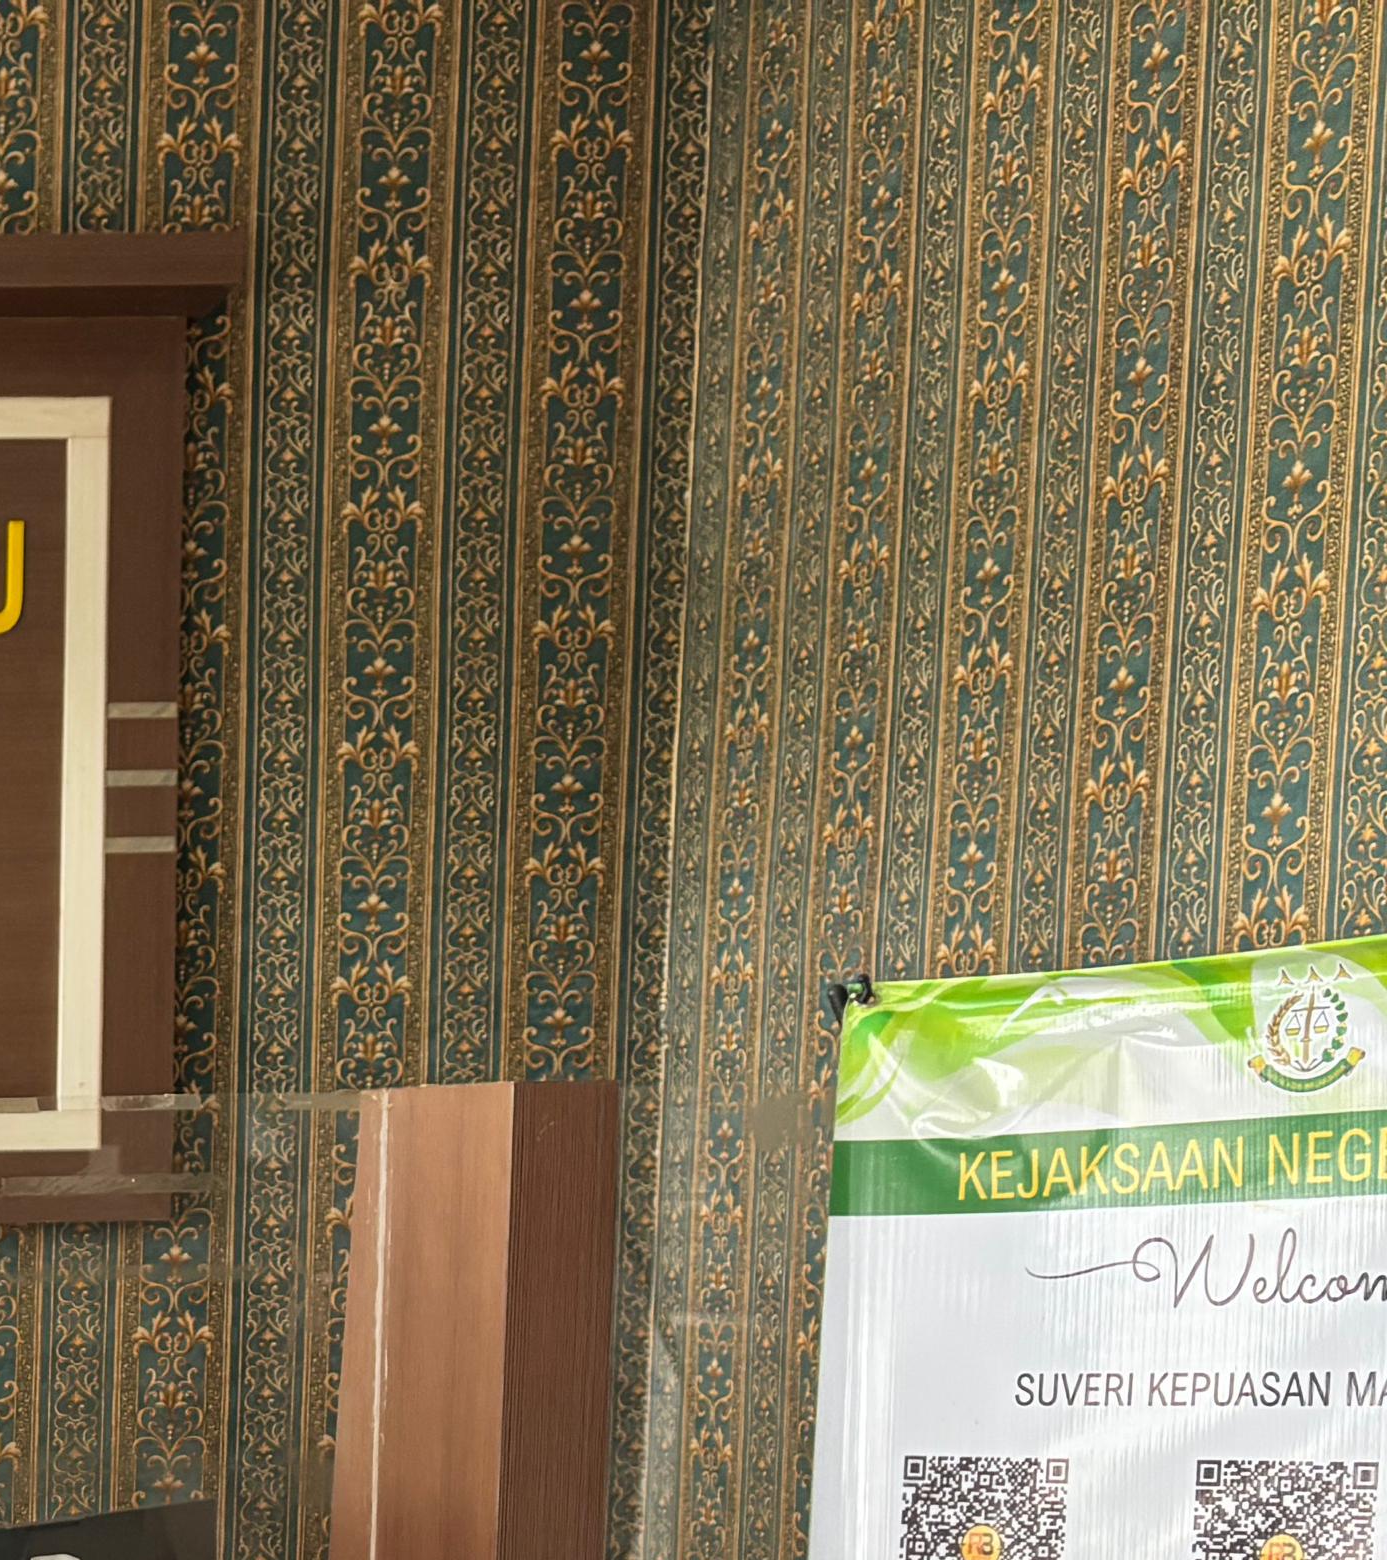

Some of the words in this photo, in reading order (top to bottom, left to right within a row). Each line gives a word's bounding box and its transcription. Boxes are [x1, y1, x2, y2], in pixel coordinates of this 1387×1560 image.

[958, 1136, 1245, 1201] KEJAKSAAN
[1014, 1372, 1134, 1408] SUVERI
[1147, 1371, 1331, 1407] KEPUASAN
